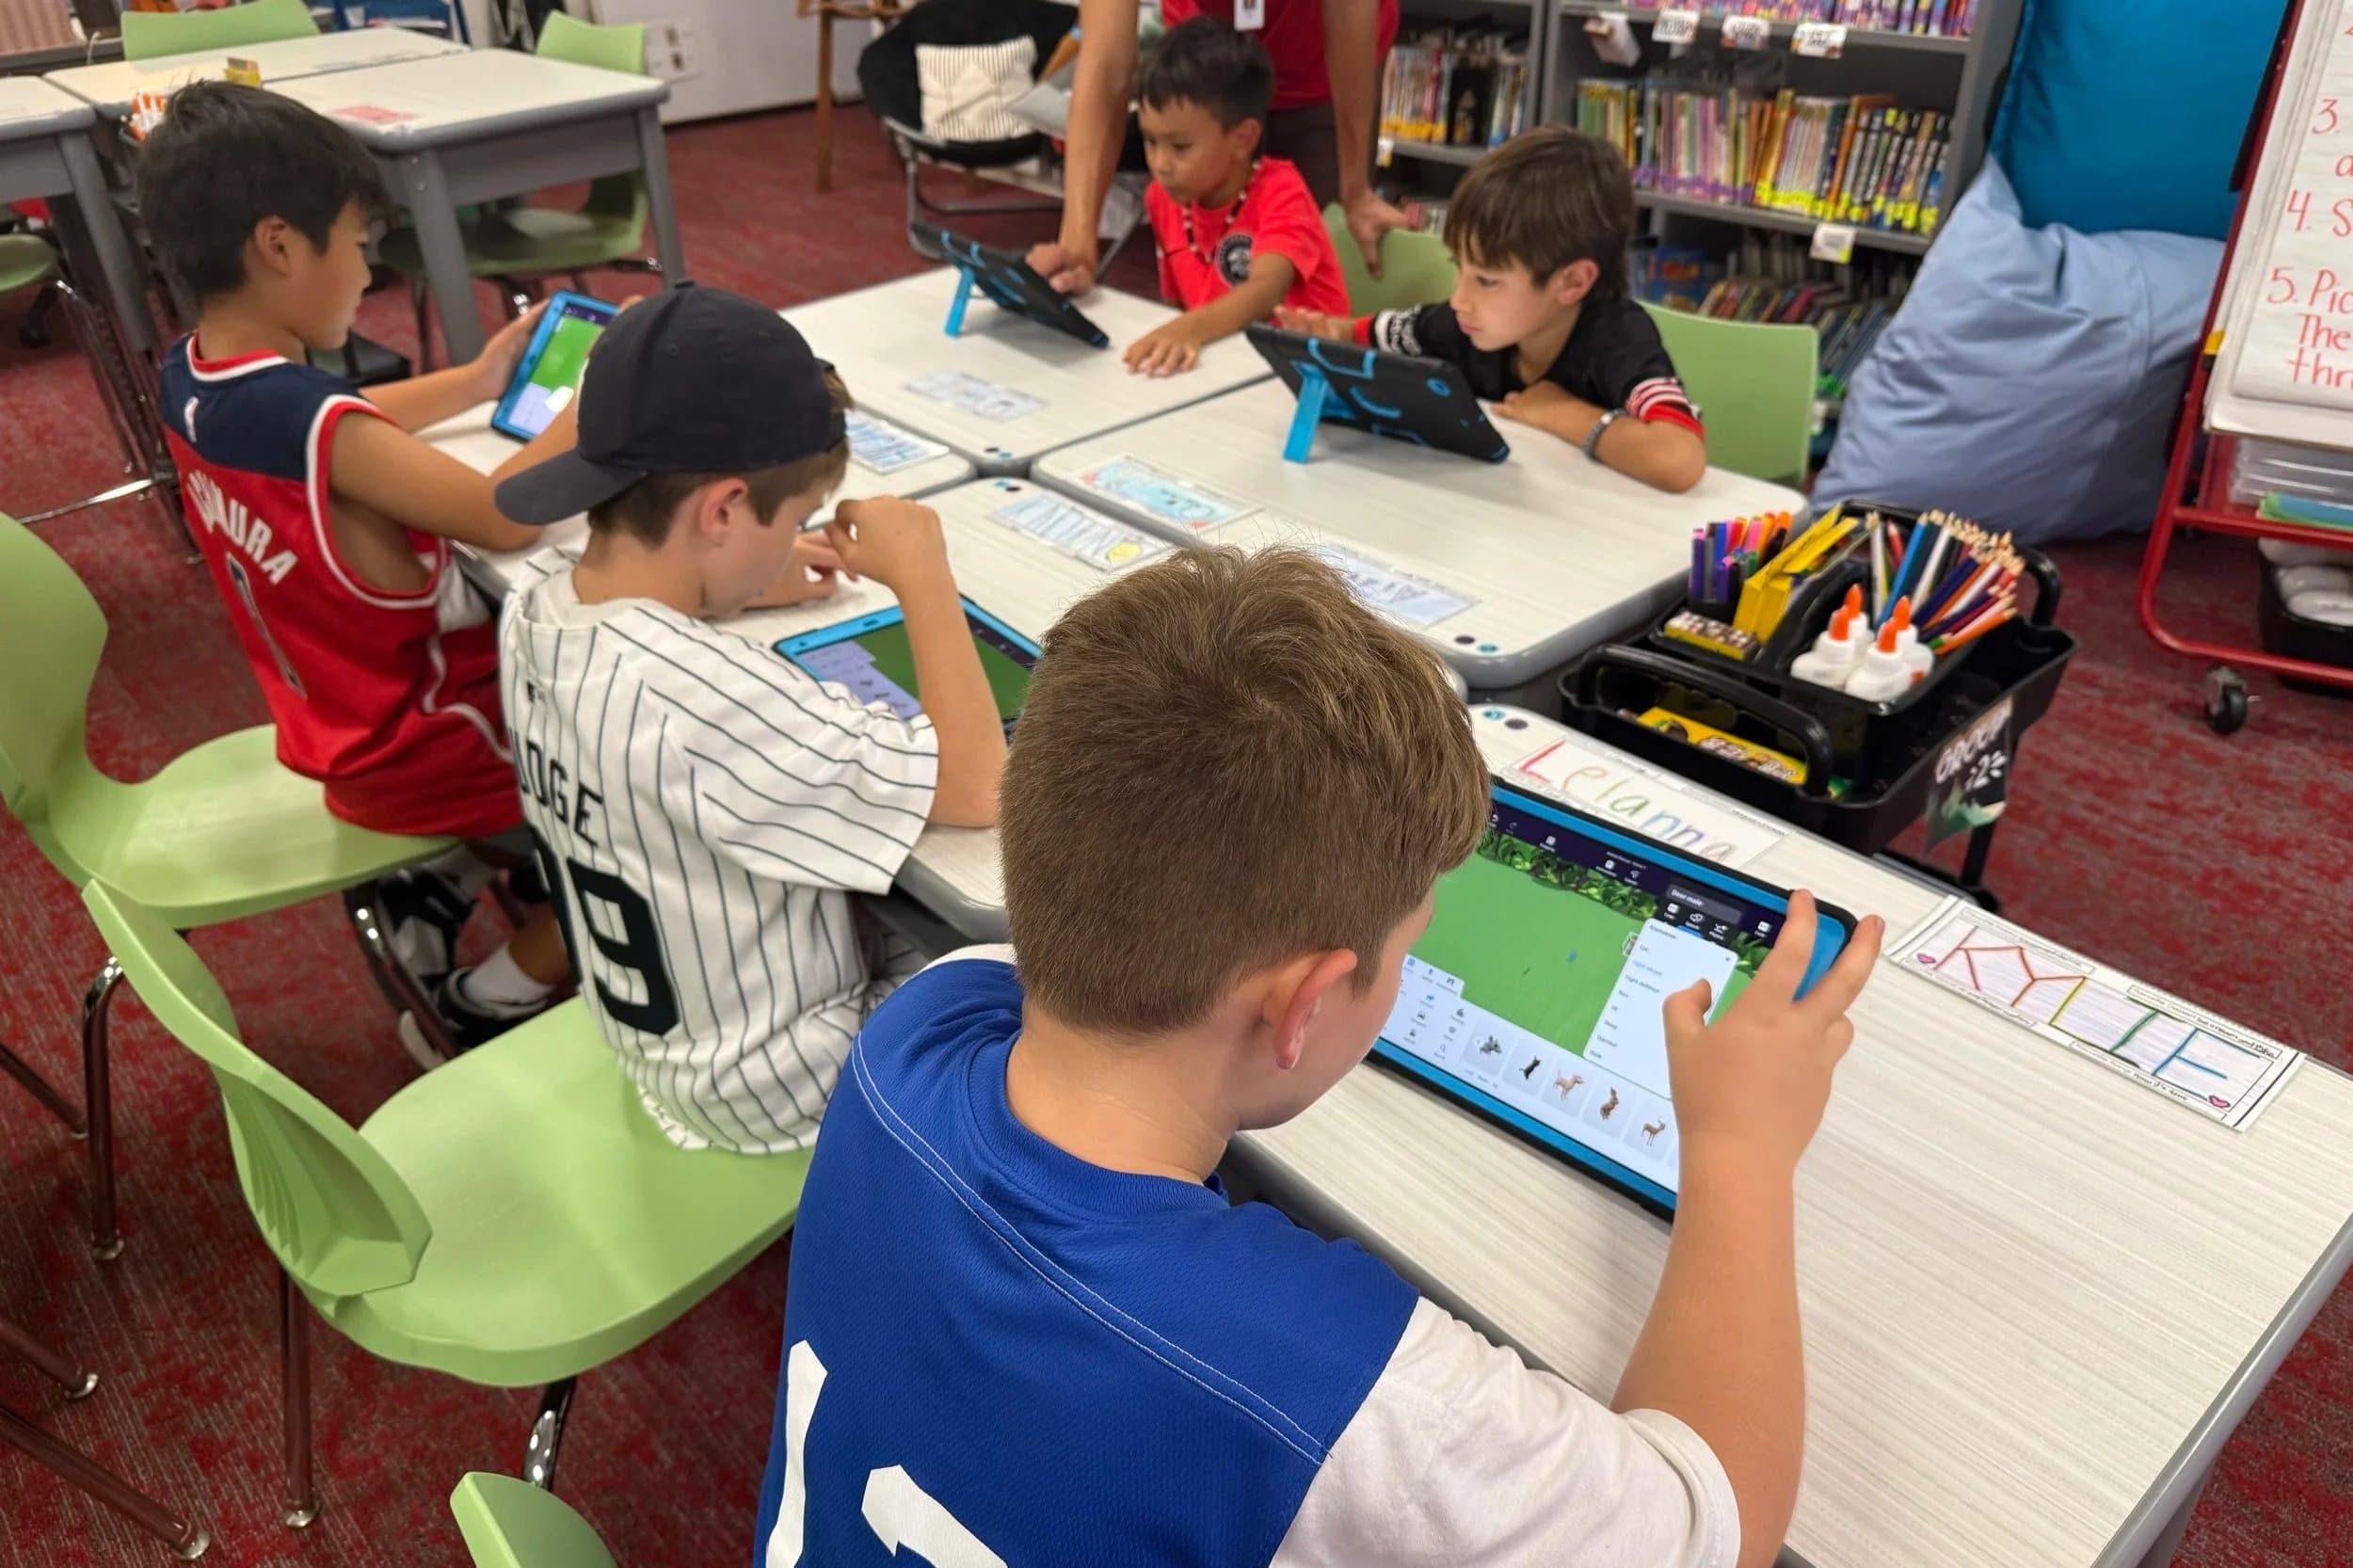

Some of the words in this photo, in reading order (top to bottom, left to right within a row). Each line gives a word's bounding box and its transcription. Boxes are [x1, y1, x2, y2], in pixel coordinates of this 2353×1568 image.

[2287, 189, 2312, 232] 4.
[2266, 267, 2298, 305] 5.
[2297, 312, 2352, 351] The
